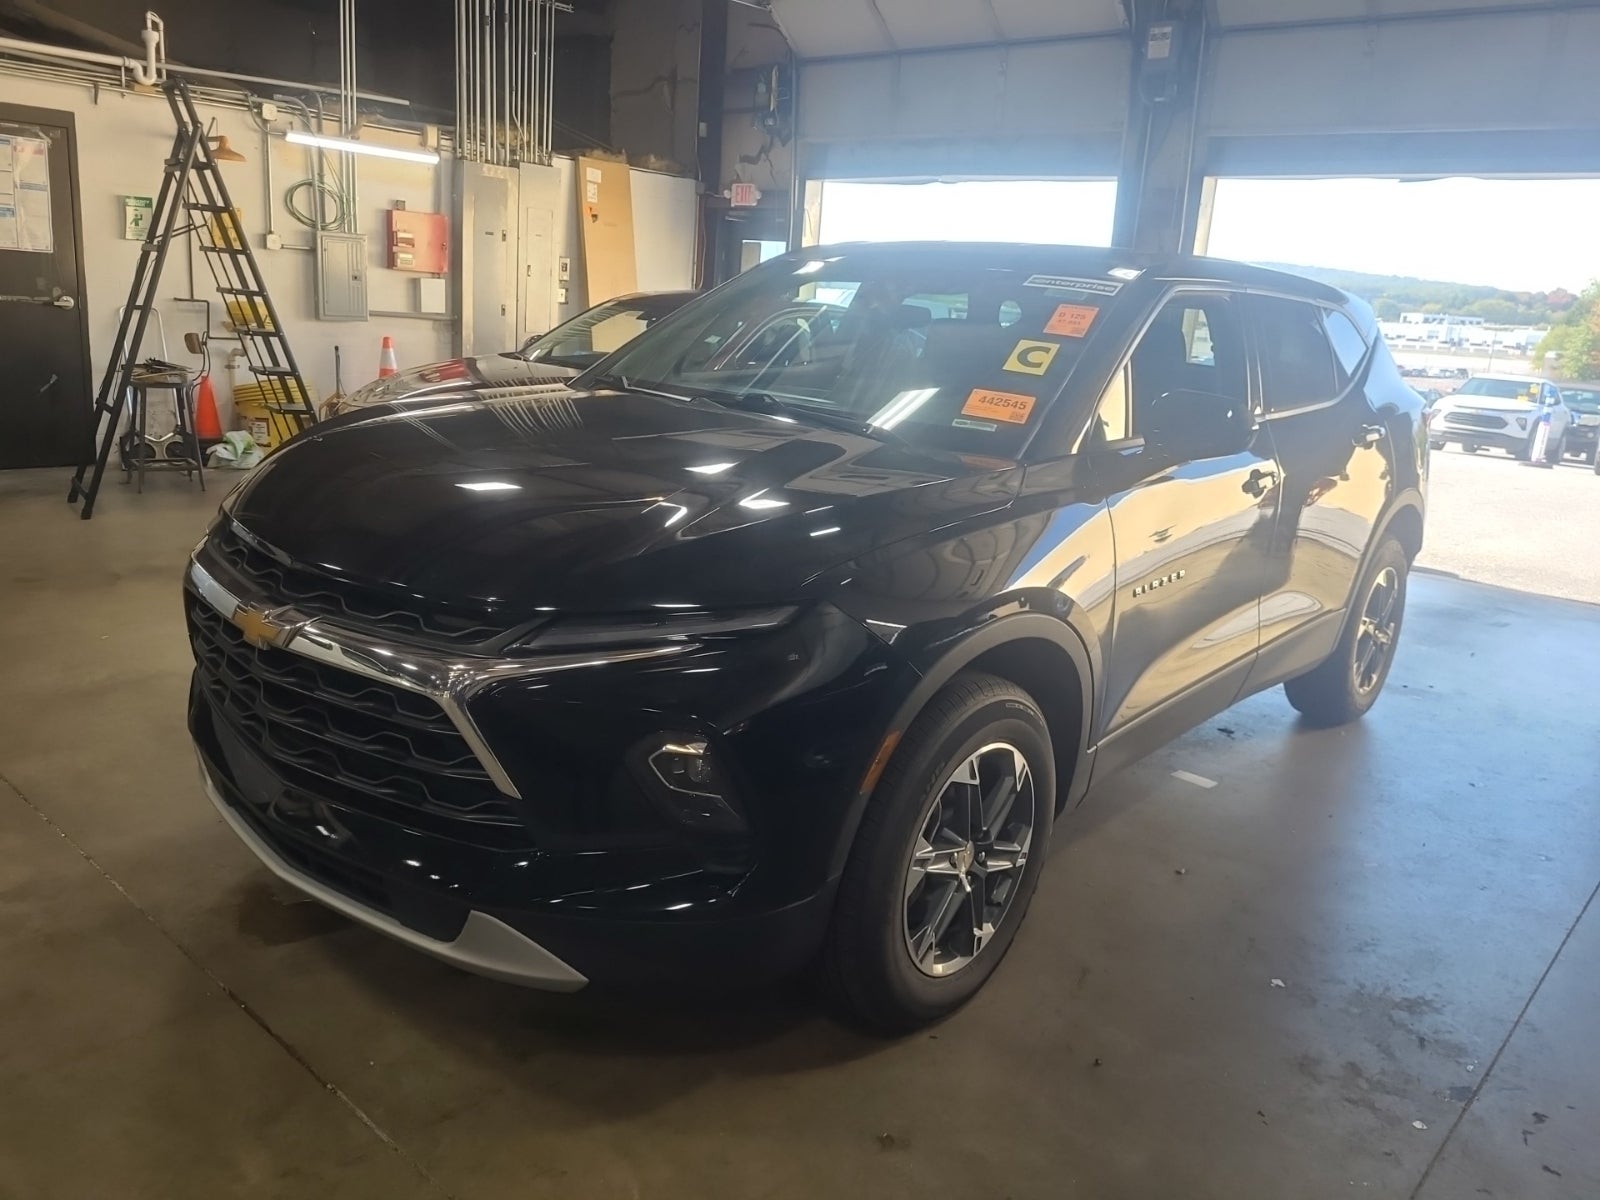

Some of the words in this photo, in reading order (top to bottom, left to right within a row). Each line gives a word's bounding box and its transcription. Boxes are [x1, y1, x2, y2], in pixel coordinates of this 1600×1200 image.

[1032, 278, 1116, 292] enterprise
[1017, 346, 1051, 369] C
[978, 396, 1029, 410] 442545
